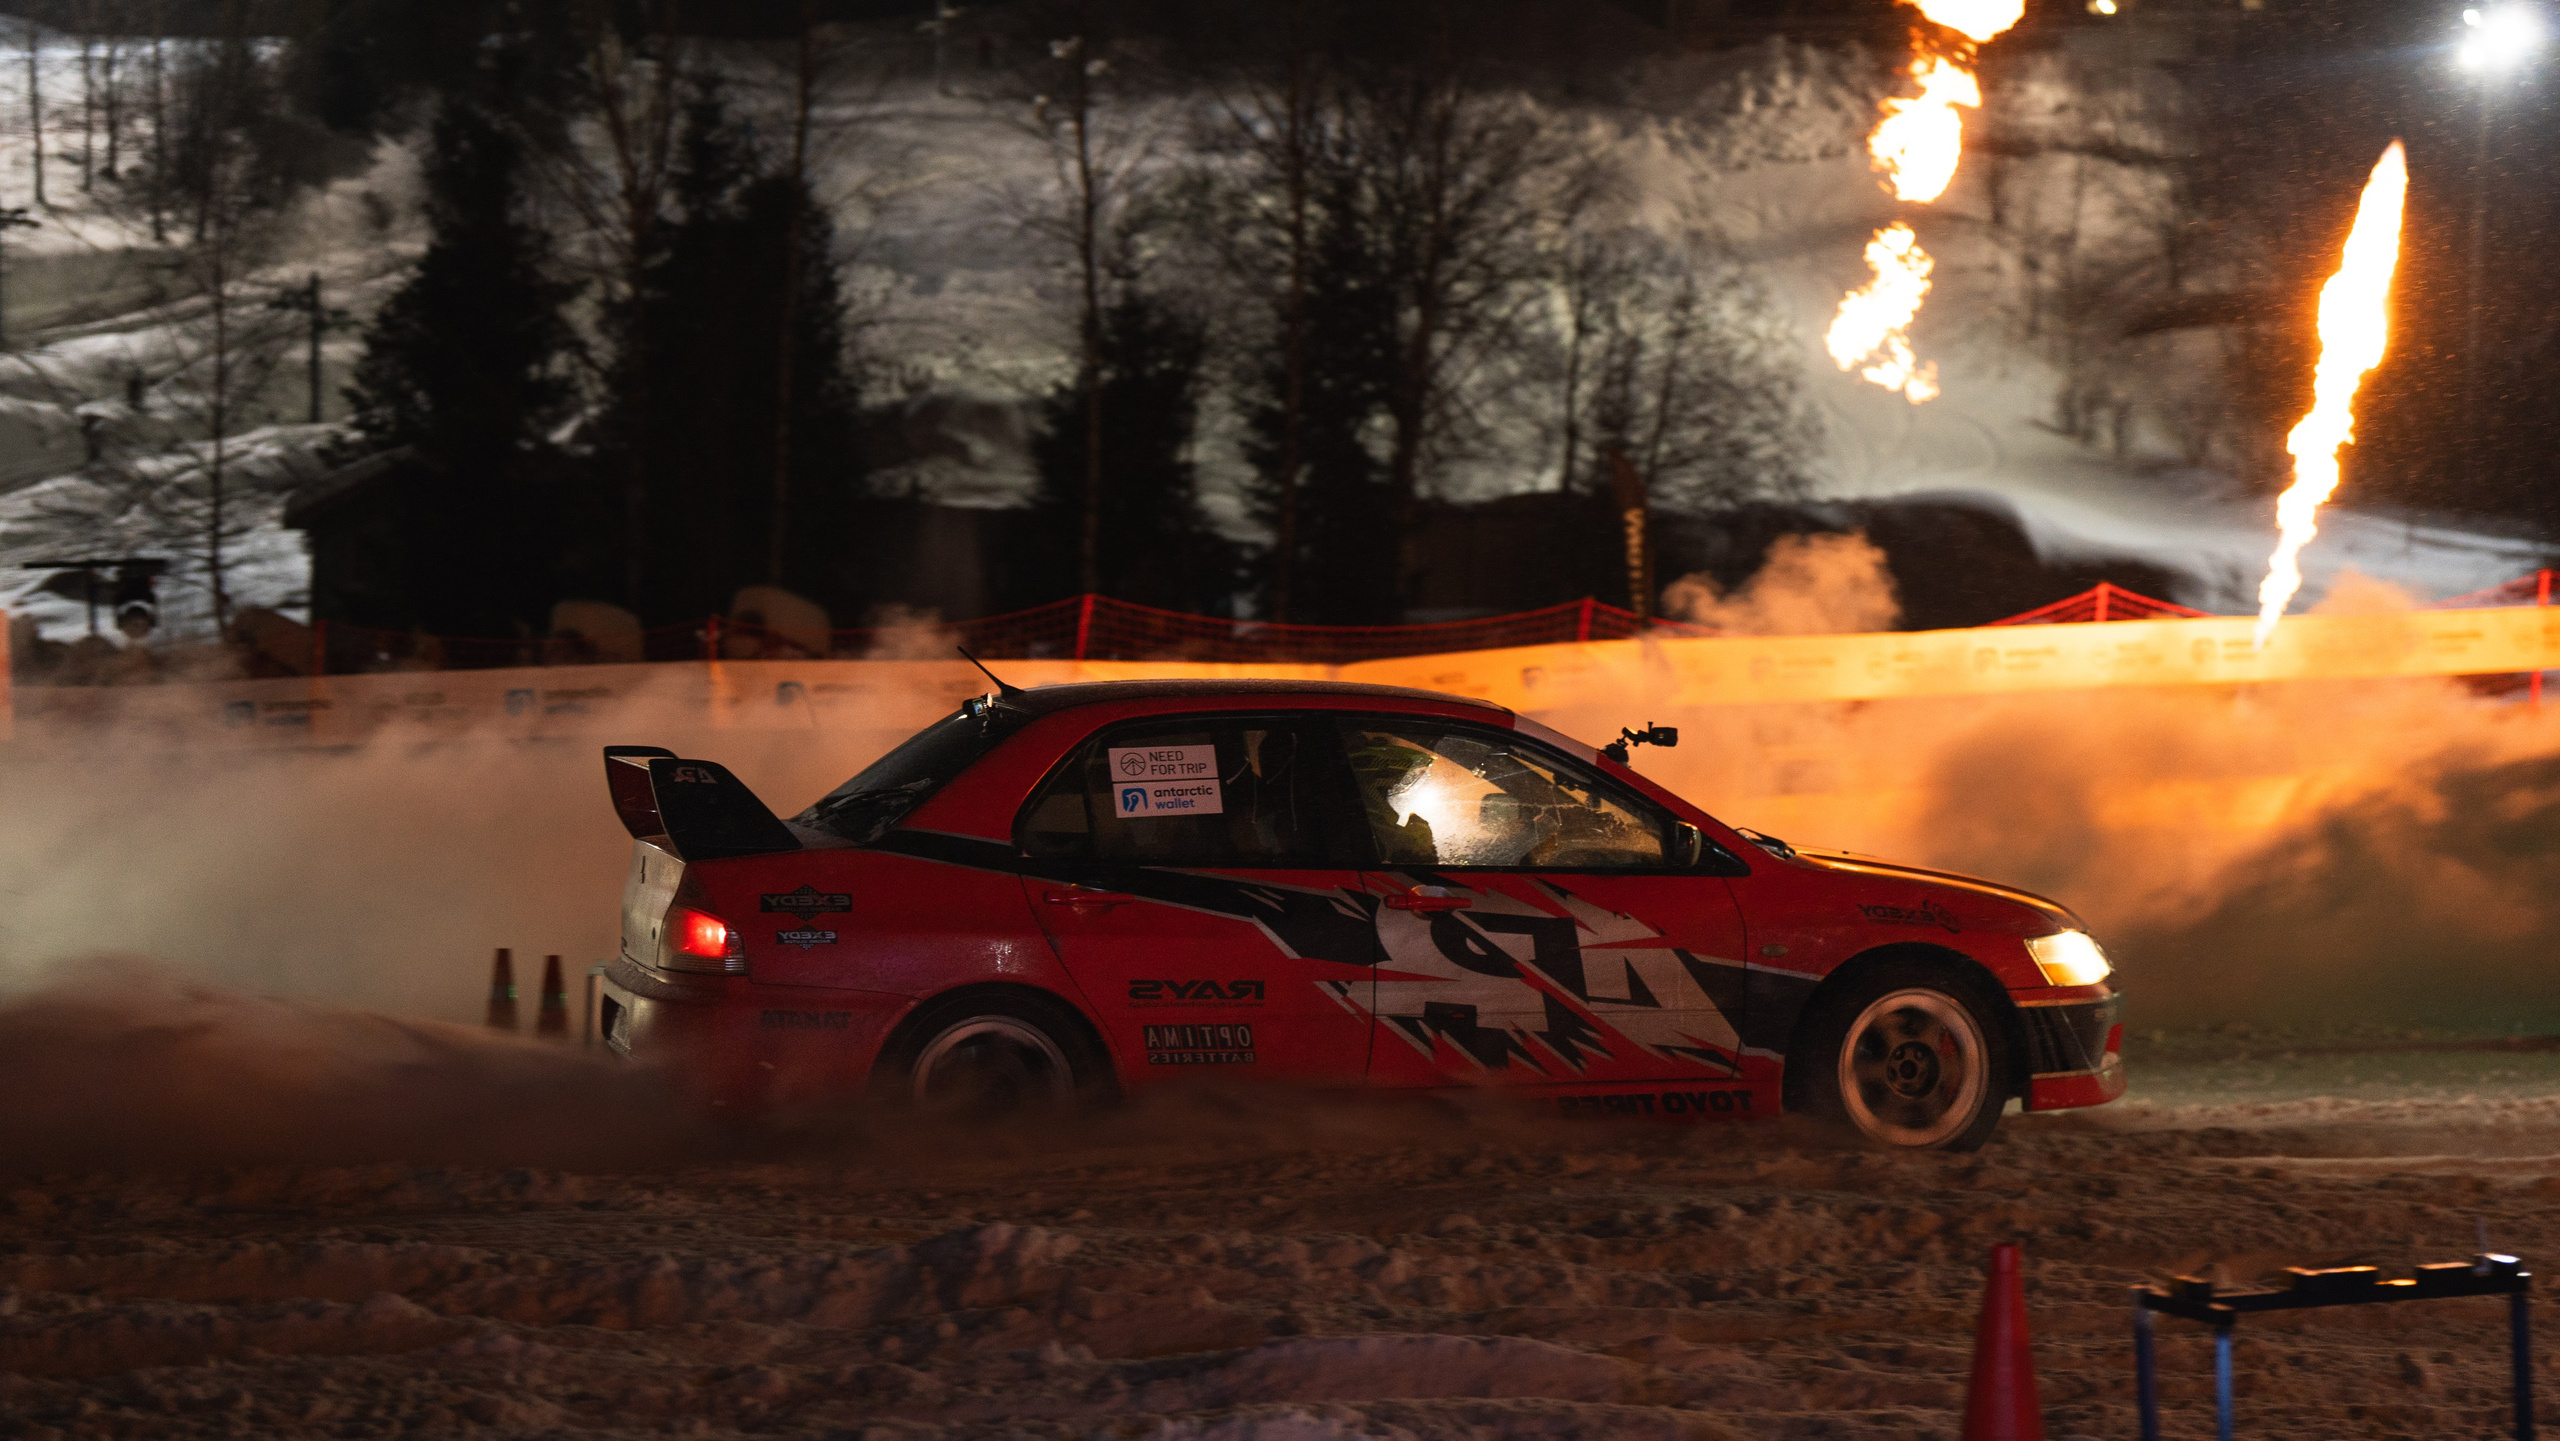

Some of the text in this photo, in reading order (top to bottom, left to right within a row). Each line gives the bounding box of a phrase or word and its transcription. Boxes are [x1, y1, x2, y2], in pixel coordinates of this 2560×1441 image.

[1149, 750, 1184, 762] NEED
[1151, 763, 1207, 775] FOR TRIP
[1153, 785, 1213, 798] antarctic
[1155, 798, 1195, 809] wallet
